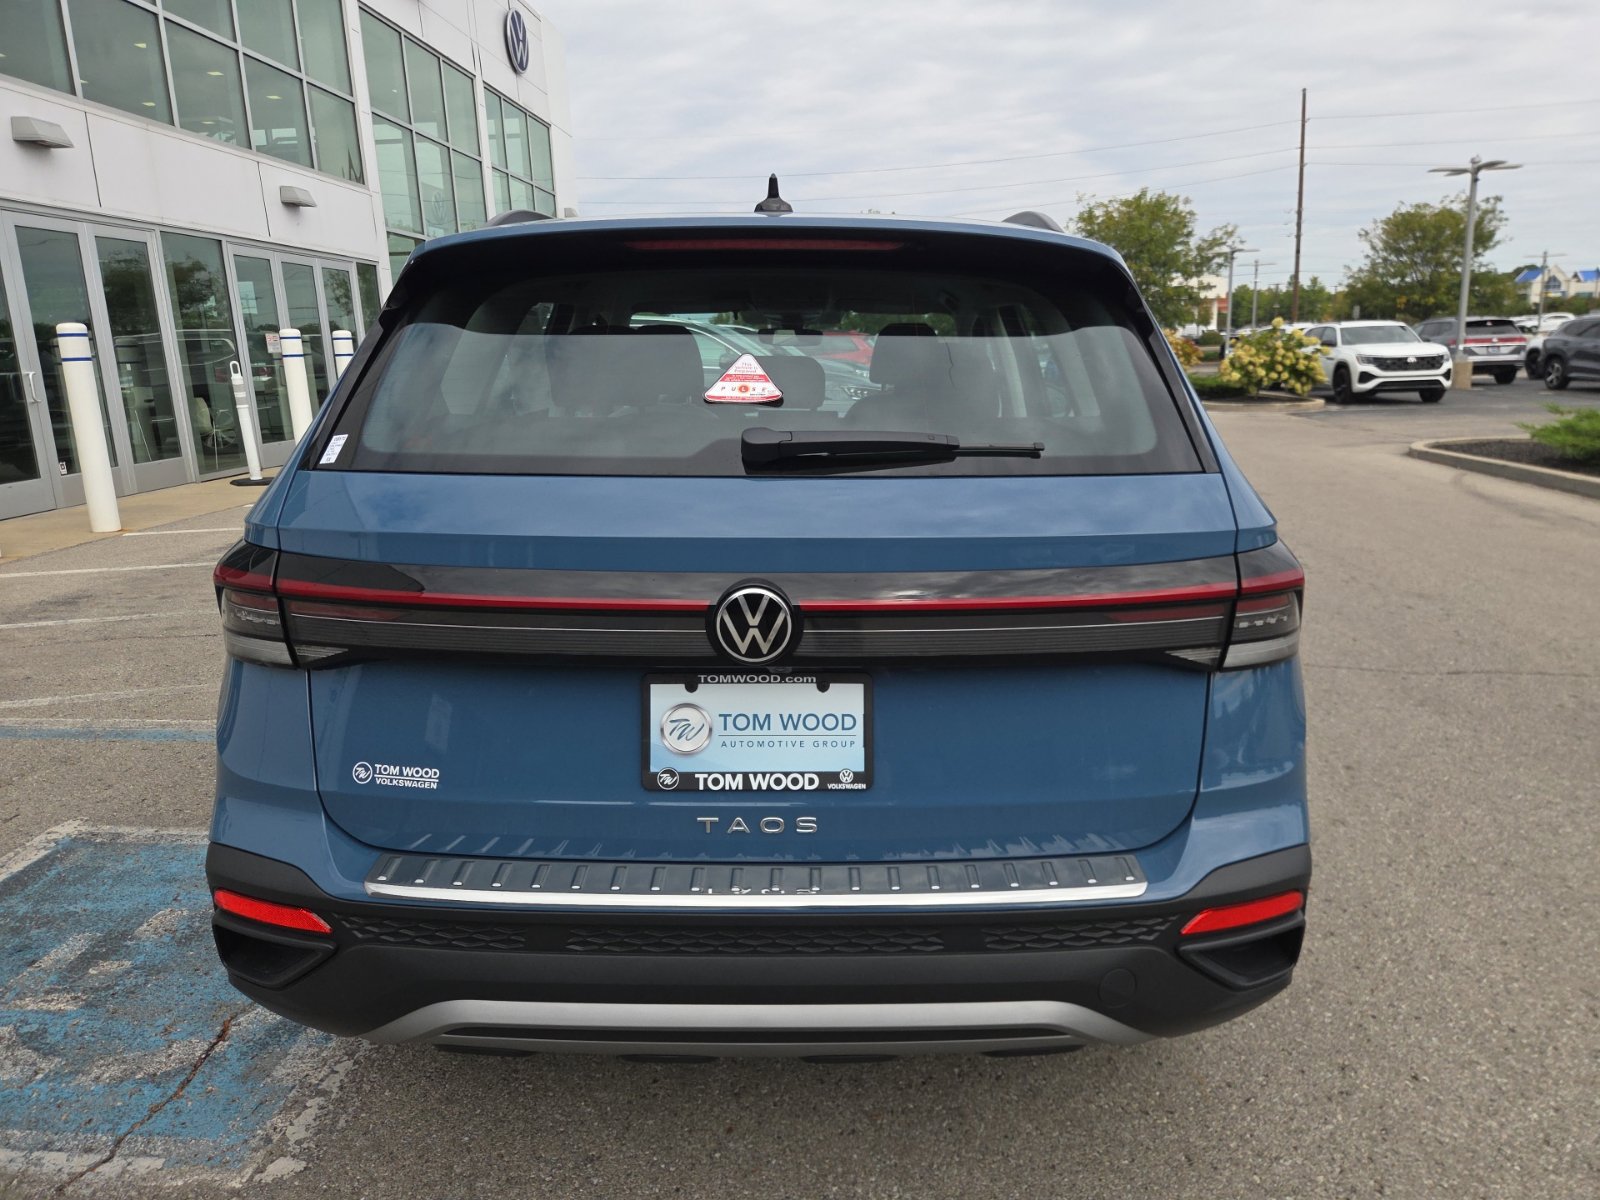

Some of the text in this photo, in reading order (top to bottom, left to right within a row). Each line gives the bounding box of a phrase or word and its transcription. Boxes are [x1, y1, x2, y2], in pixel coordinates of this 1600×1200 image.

[698, 674, 817, 684] TOMWOOD.com
[718, 713, 857, 731] TOM WOOD
[721, 740, 856, 748] AUTOMOTIVE GROUP
[374, 764, 439, 778] TOM WOOD
[375, 777, 438, 789] VOLKSWAGEN
[695, 773, 820, 791] TOM WOOD
[696, 816, 818, 834] TAOS
